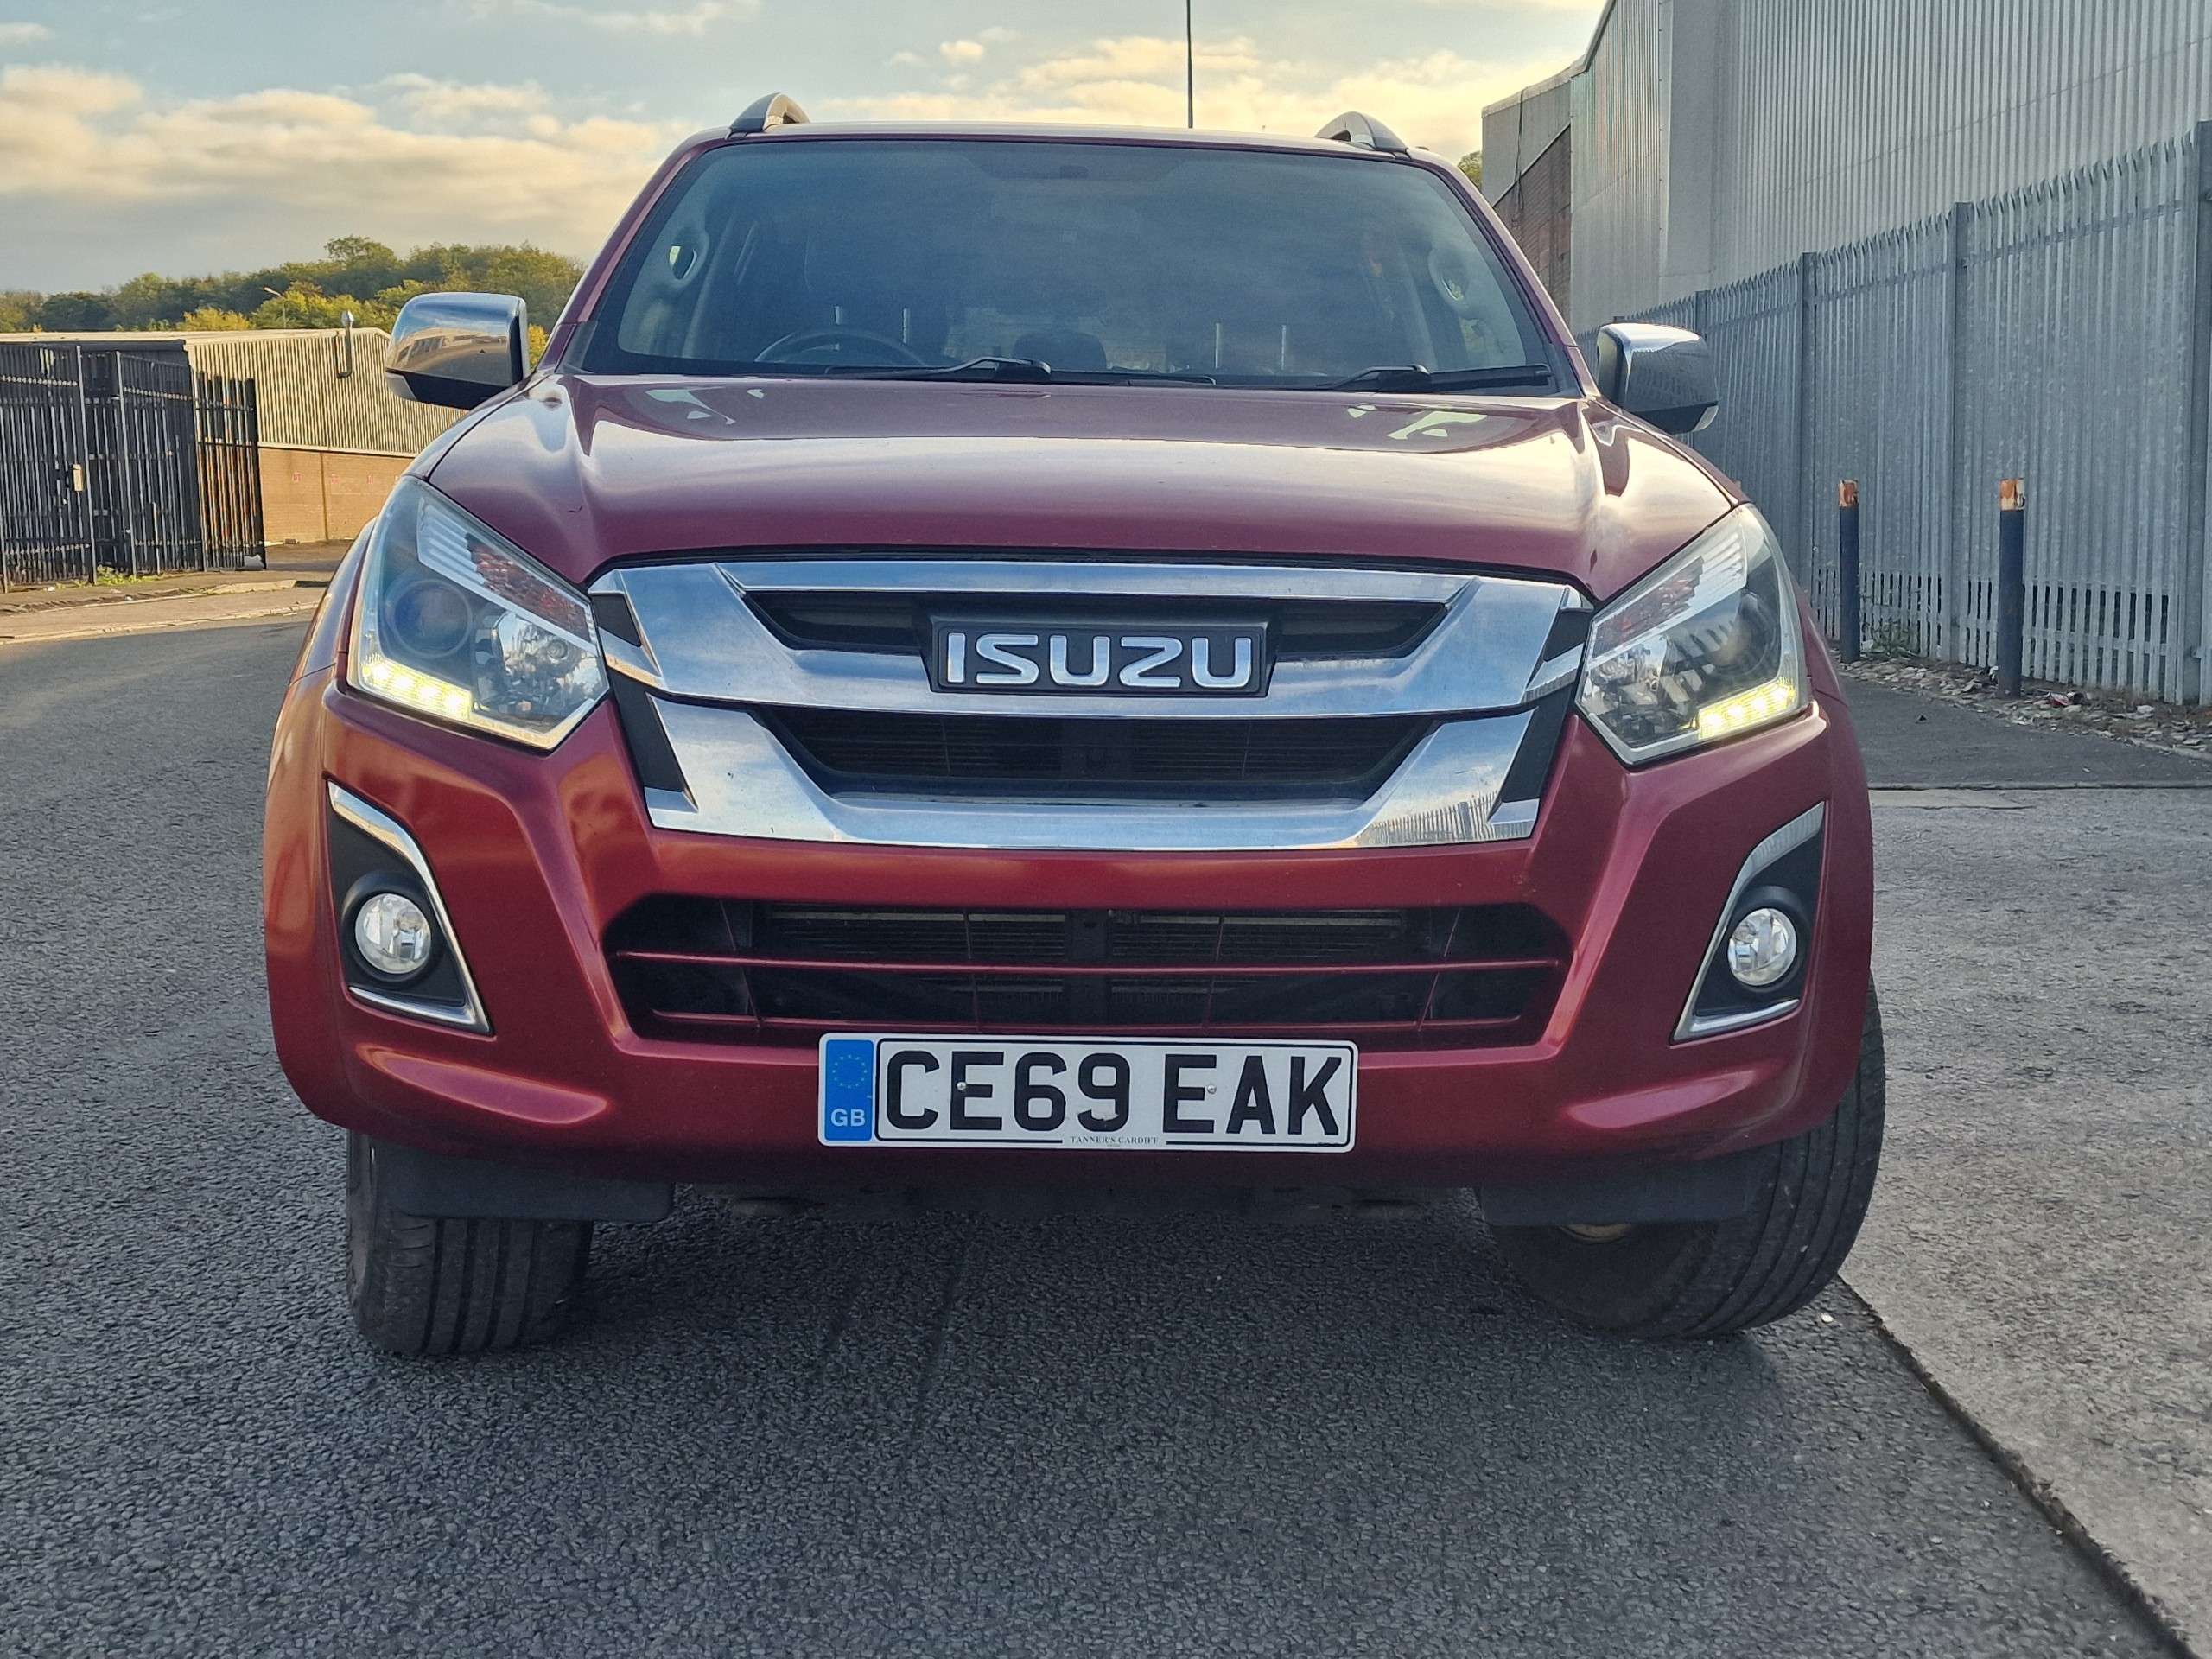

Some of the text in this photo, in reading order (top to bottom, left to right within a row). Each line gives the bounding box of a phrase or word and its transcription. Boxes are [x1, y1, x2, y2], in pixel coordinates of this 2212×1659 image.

[947, 632, 1252, 689] ISUZU
[886, 1050, 1343, 1136] CE69 EAK
[830, 1108, 866, 1127] GB
[1071, 1135, 1158, 1145] TANNER'S CARDIFF
